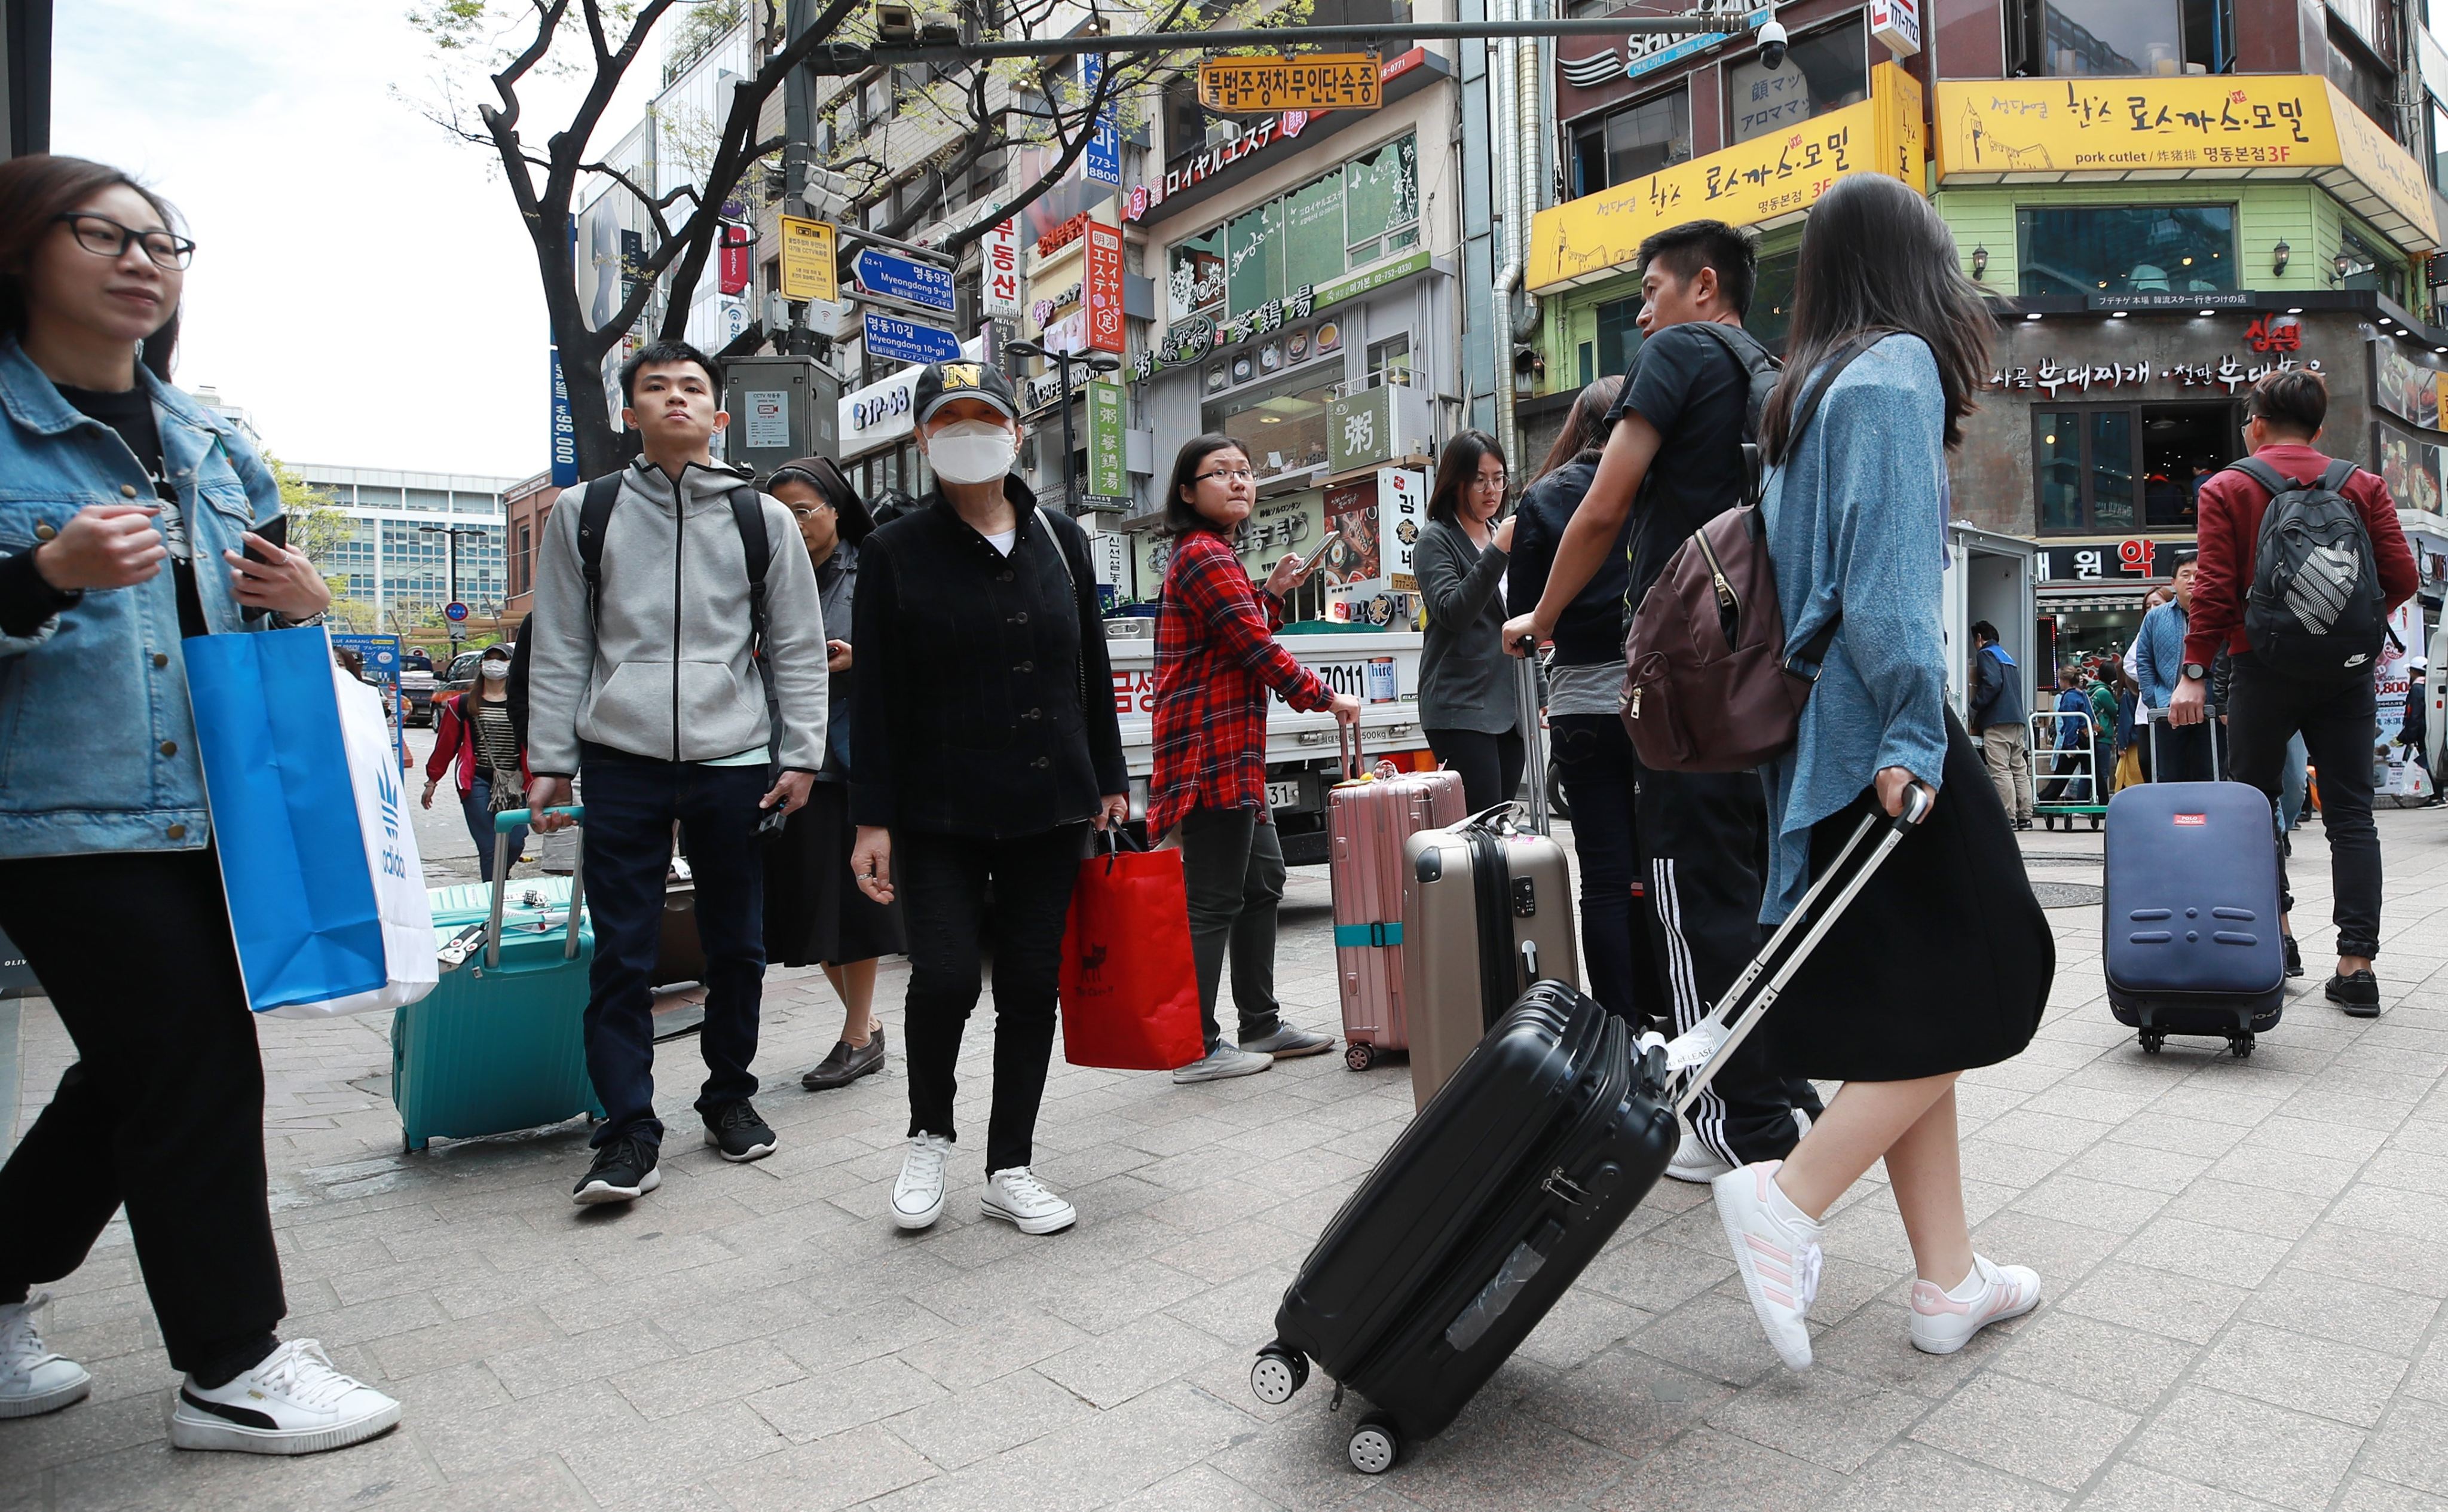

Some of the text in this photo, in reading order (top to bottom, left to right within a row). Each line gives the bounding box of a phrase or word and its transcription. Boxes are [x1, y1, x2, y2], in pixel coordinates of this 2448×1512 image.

[1676, 44, 1694, 57] Skin
[1697, 34, 1718, 48] Care
[1088, 154, 1116, 169] 773-
[1167, 117, 1276, 196] ロイヤルエステ
[2076, 151, 2106, 165] pork
[2109, 151, 2146, 163] cutlet
[2157, 149, 2198, 162] 炸猪排
[2204, 146, 2265, 162] 명동본점
[2268, 146, 2290, 162] 3F
[1088, 167, 1119, 183] 8800
[1758, 190, 1802, 214] 명동본점
[1094, 232, 1117, 249] 明洞
[991, 217, 1016, 301] 부동산
[1093, 248, 1106, 292] エステ
[881, 272, 951, 298] Myeongdong 9-gil
[913, 266, 950, 288] 명동9길
[1108, 252, 1119, 307] ロイヤル
[1350, 276, 1371, 292] 미가본
[1375, 262, 1412, 283] 02-752-0330
[868, 317, 914, 339] 명동10길
[1101, 314, 1113, 328] 足
[869, 332, 945, 356] Myeongdong 10-gil
[1096, 334, 1103, 342] 3F
[942, 363, 982, 391] N
[1134, 350, 1150, 381] 粥
[555, 380, 567, 400] SUIT
[2037, 357, 2150, 399] 부대찌개
[2174, 363, 2212, 387] 철판
[1037, 379, 1062, 403] CAFE
[1344, 409, 1374, 457] 粥
[1375, 448, 1382, 458] 2F
[1371, 663, 1391, 677] hite
